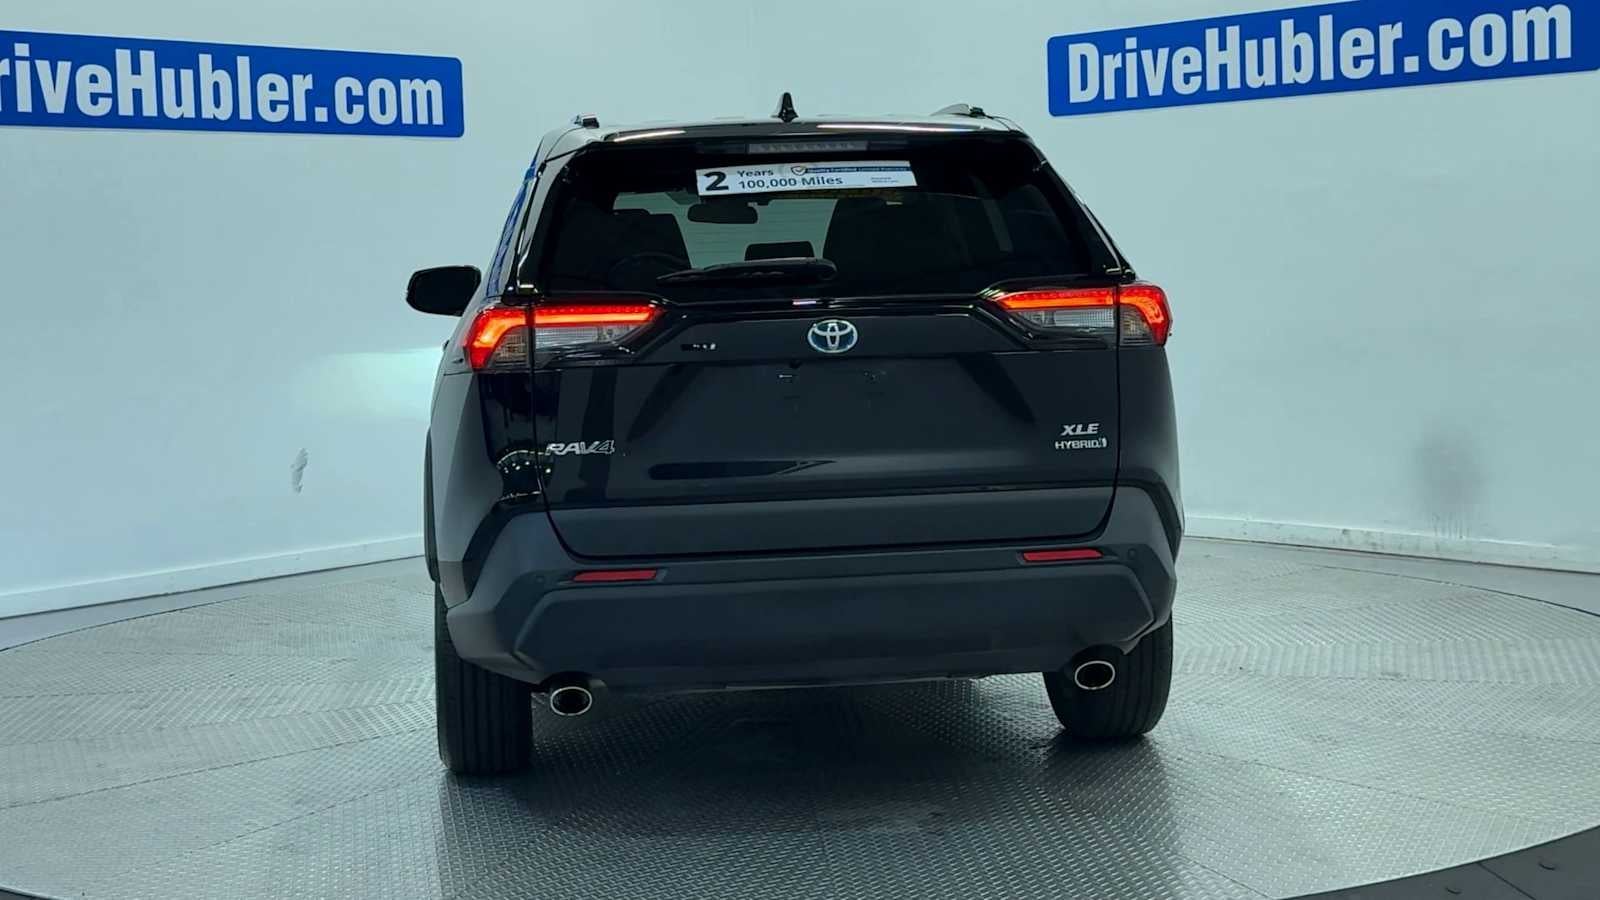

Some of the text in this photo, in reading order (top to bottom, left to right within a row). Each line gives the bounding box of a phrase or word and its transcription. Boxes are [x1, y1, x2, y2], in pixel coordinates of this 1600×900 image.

[1067, 3, 1572, 104] DriveHubler.com
[704, 171, 729, 191] 2
[736, 169, 774, 178] Years
[738, 175, 844, 189] 100,000 Miles
[1060, 422, 1100, 436] XLE
[545, 440, 616, 456] RAV4
